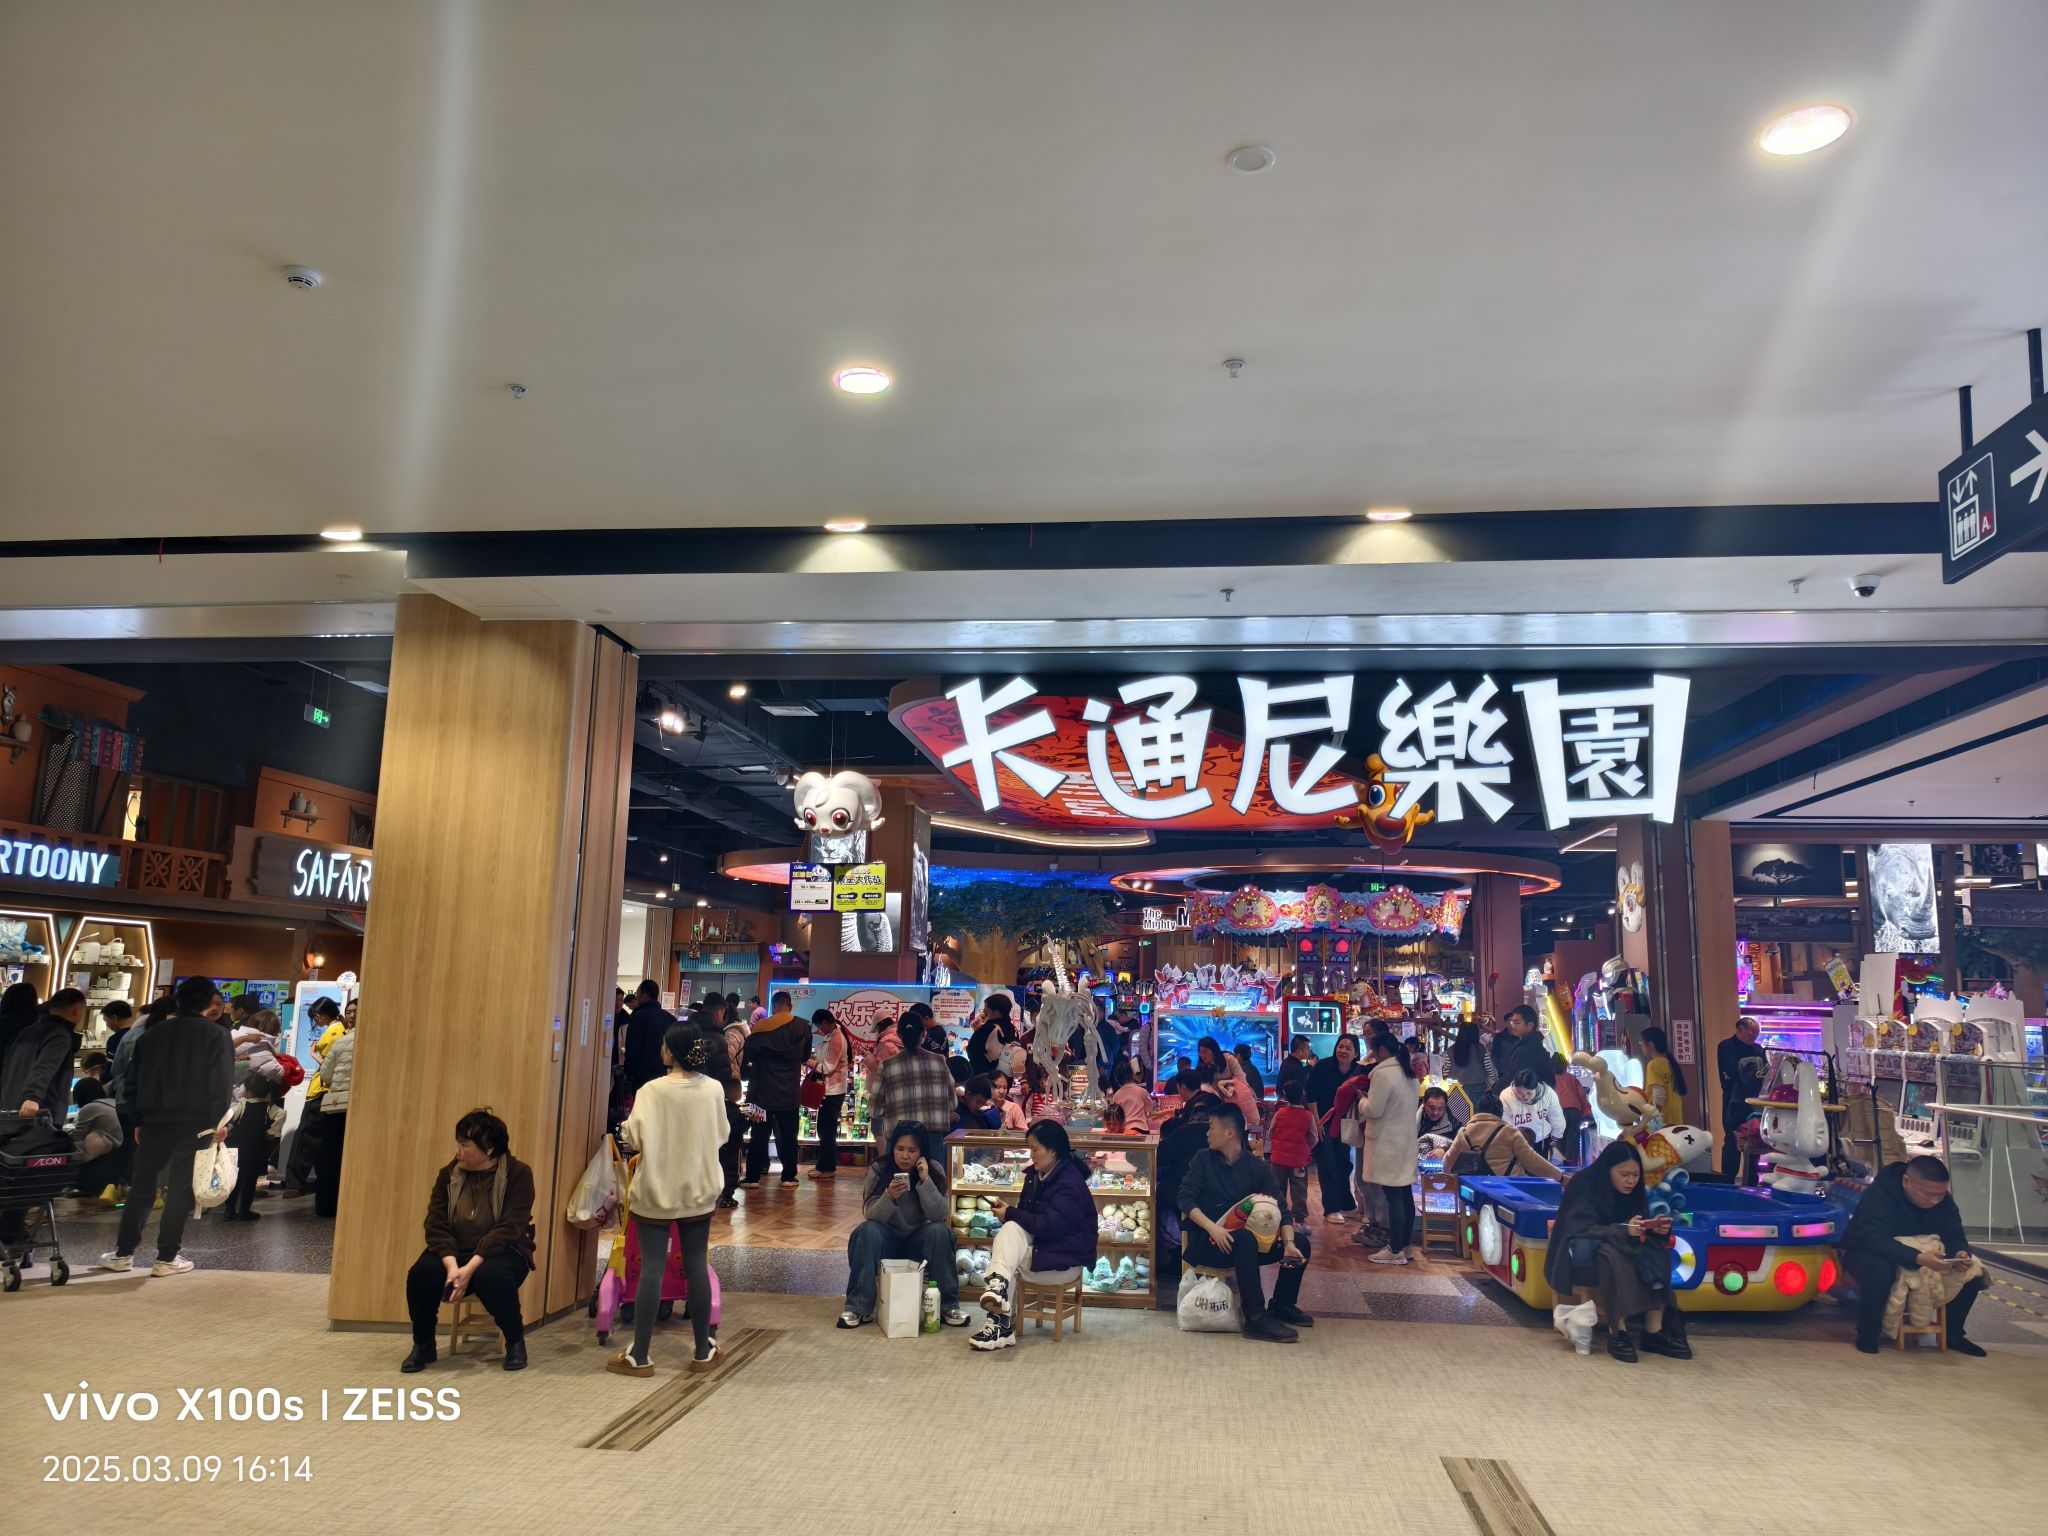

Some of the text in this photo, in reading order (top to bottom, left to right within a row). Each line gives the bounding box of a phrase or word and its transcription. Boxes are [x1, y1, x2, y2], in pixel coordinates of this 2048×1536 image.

[942, 673, 1691, 831] 卡通尼樂園
[1143, 908, 1161, 919] The
[1143, 919, 1176, 931] Mighty
